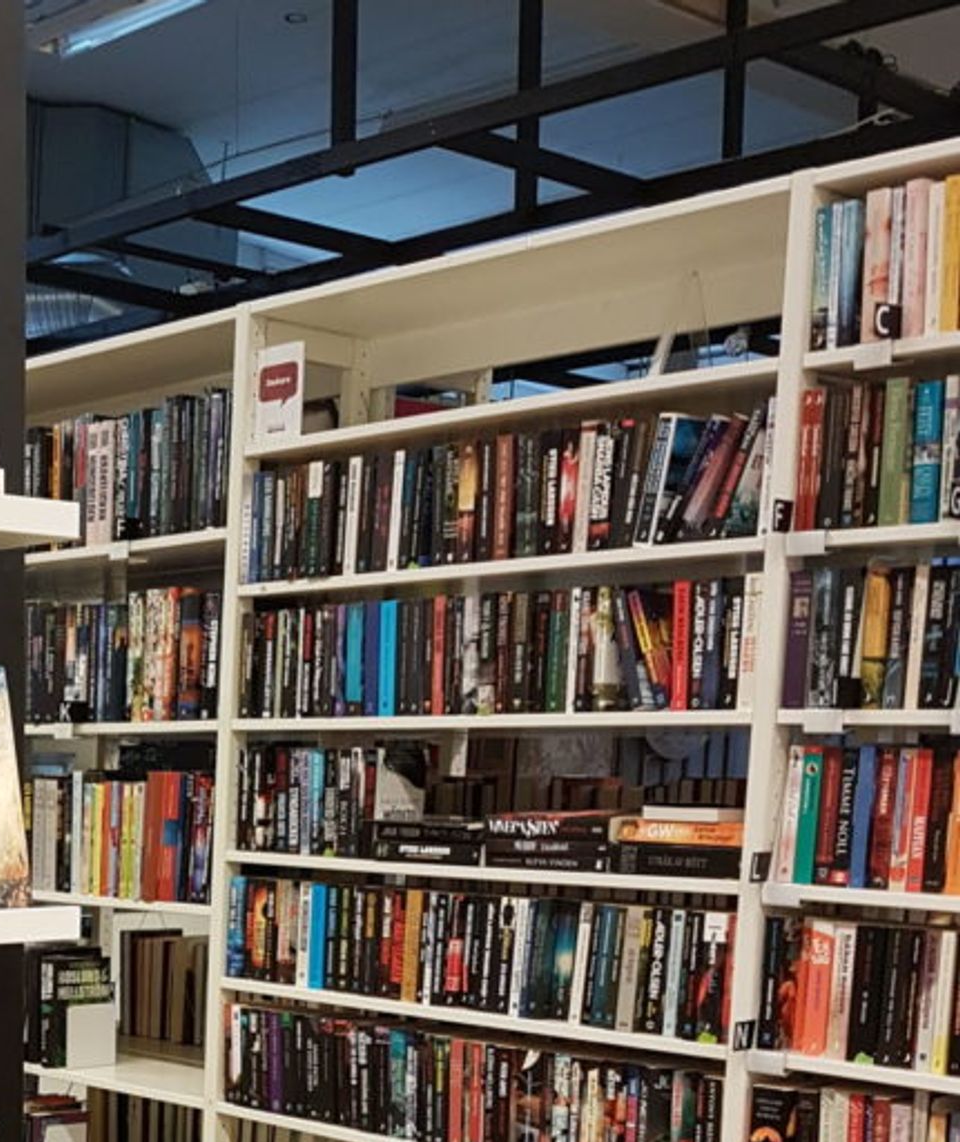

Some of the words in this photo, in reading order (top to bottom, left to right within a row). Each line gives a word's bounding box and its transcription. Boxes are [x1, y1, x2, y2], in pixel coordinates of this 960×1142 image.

[876, 305, 890, 336] C
[775, 503, 785, 530] F
[59, 702, 71, 721] K
[735, 1023, 749, 1049] N
